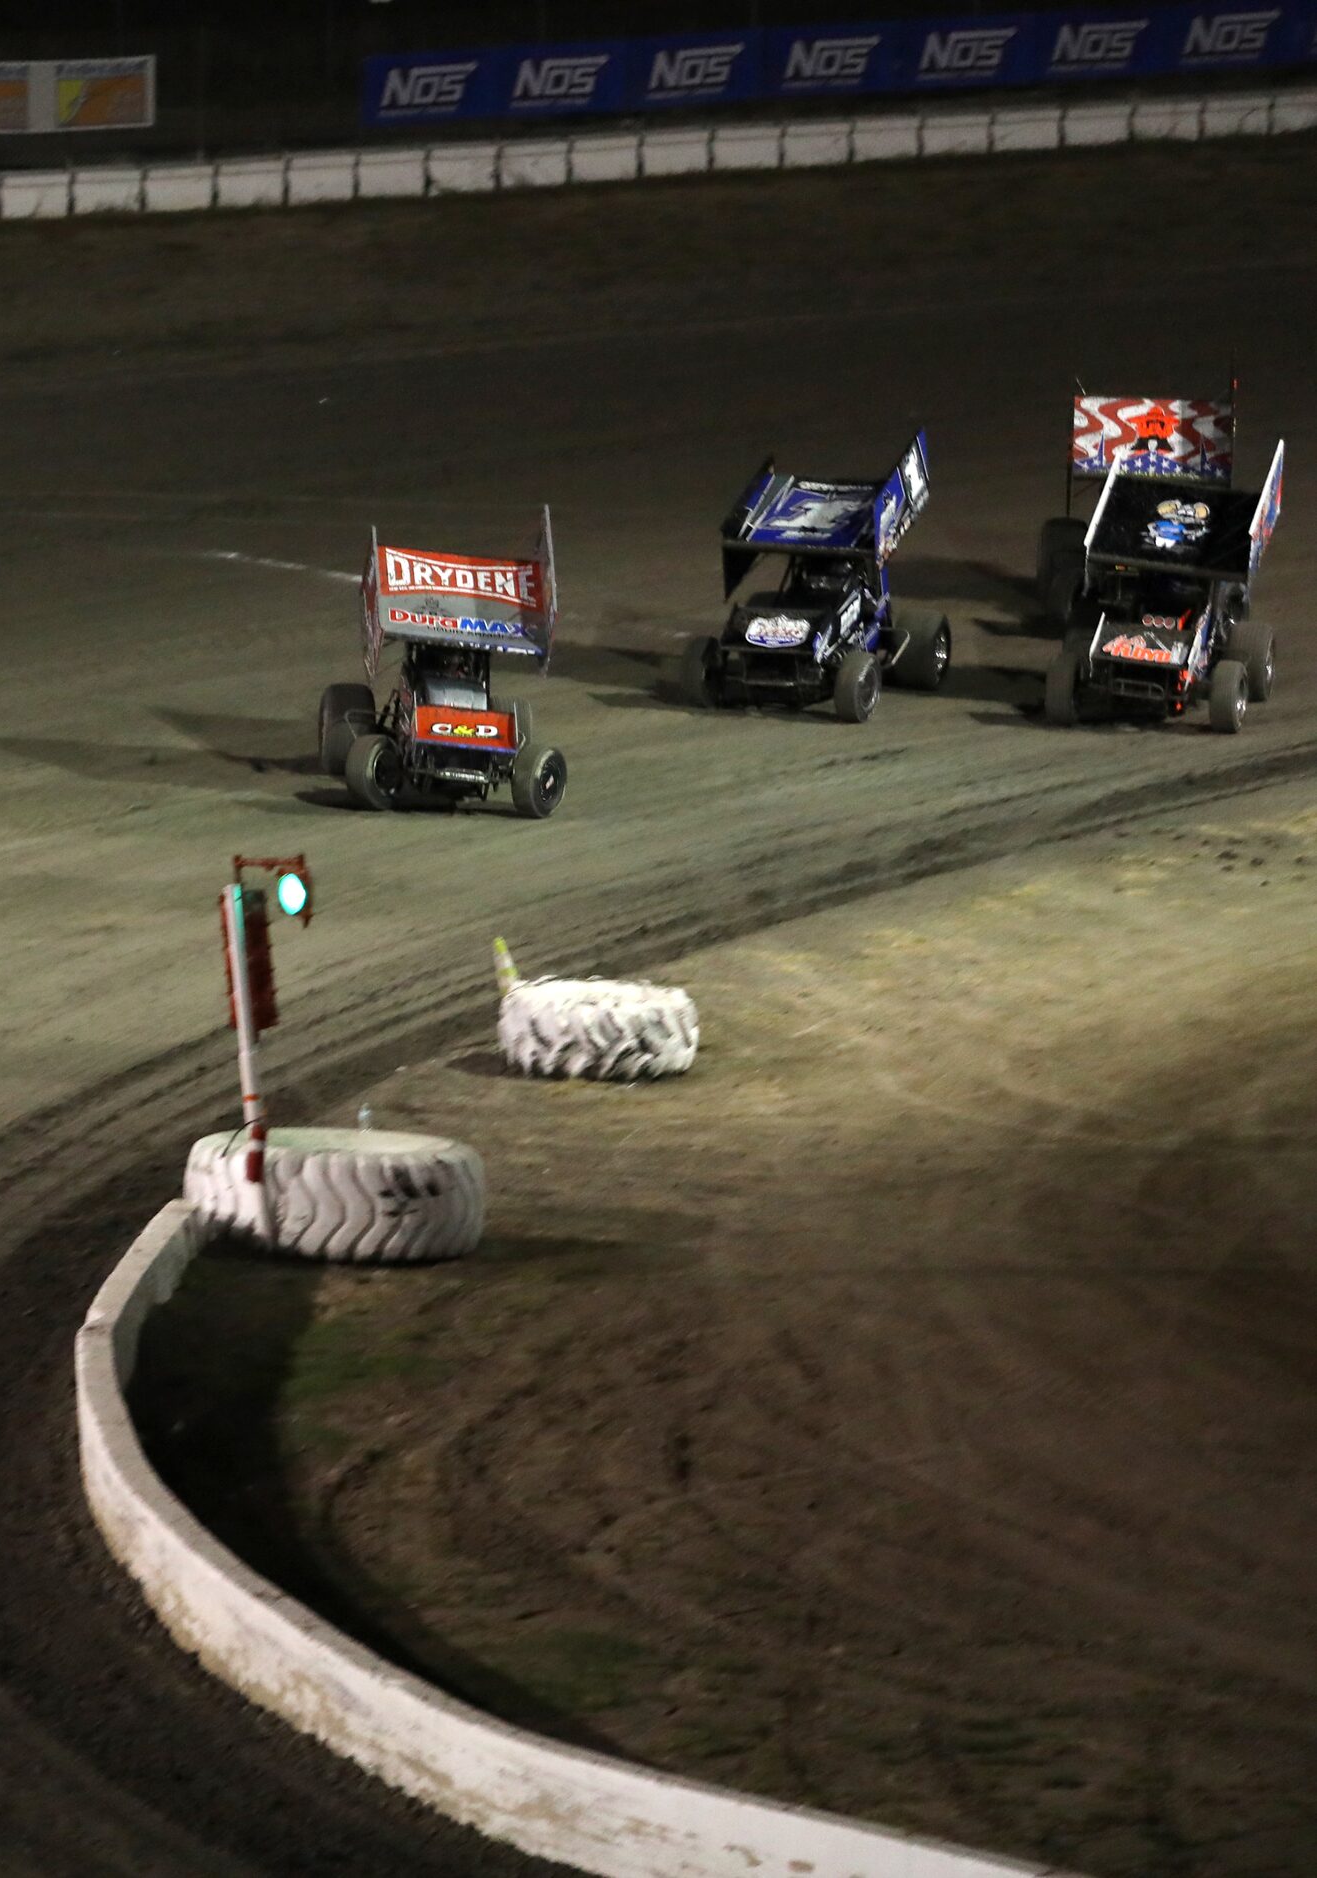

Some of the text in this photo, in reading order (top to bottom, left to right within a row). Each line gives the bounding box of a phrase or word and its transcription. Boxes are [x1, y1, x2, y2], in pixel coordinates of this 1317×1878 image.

[918, 26, 1018, 70] NOS
[1052, 18, 1149, 62] NOS
[1184, 11, 1282, 53] NOS
[513, 54, 610, 99] NOS
[649, 42, 745, 90] NOS
[784, 35, 881, 79] NOS
[380, 61, 480, 107] NOS
[386, 553, 536, 606] DRYDENE
[431, 723, 498, 737] C&D
